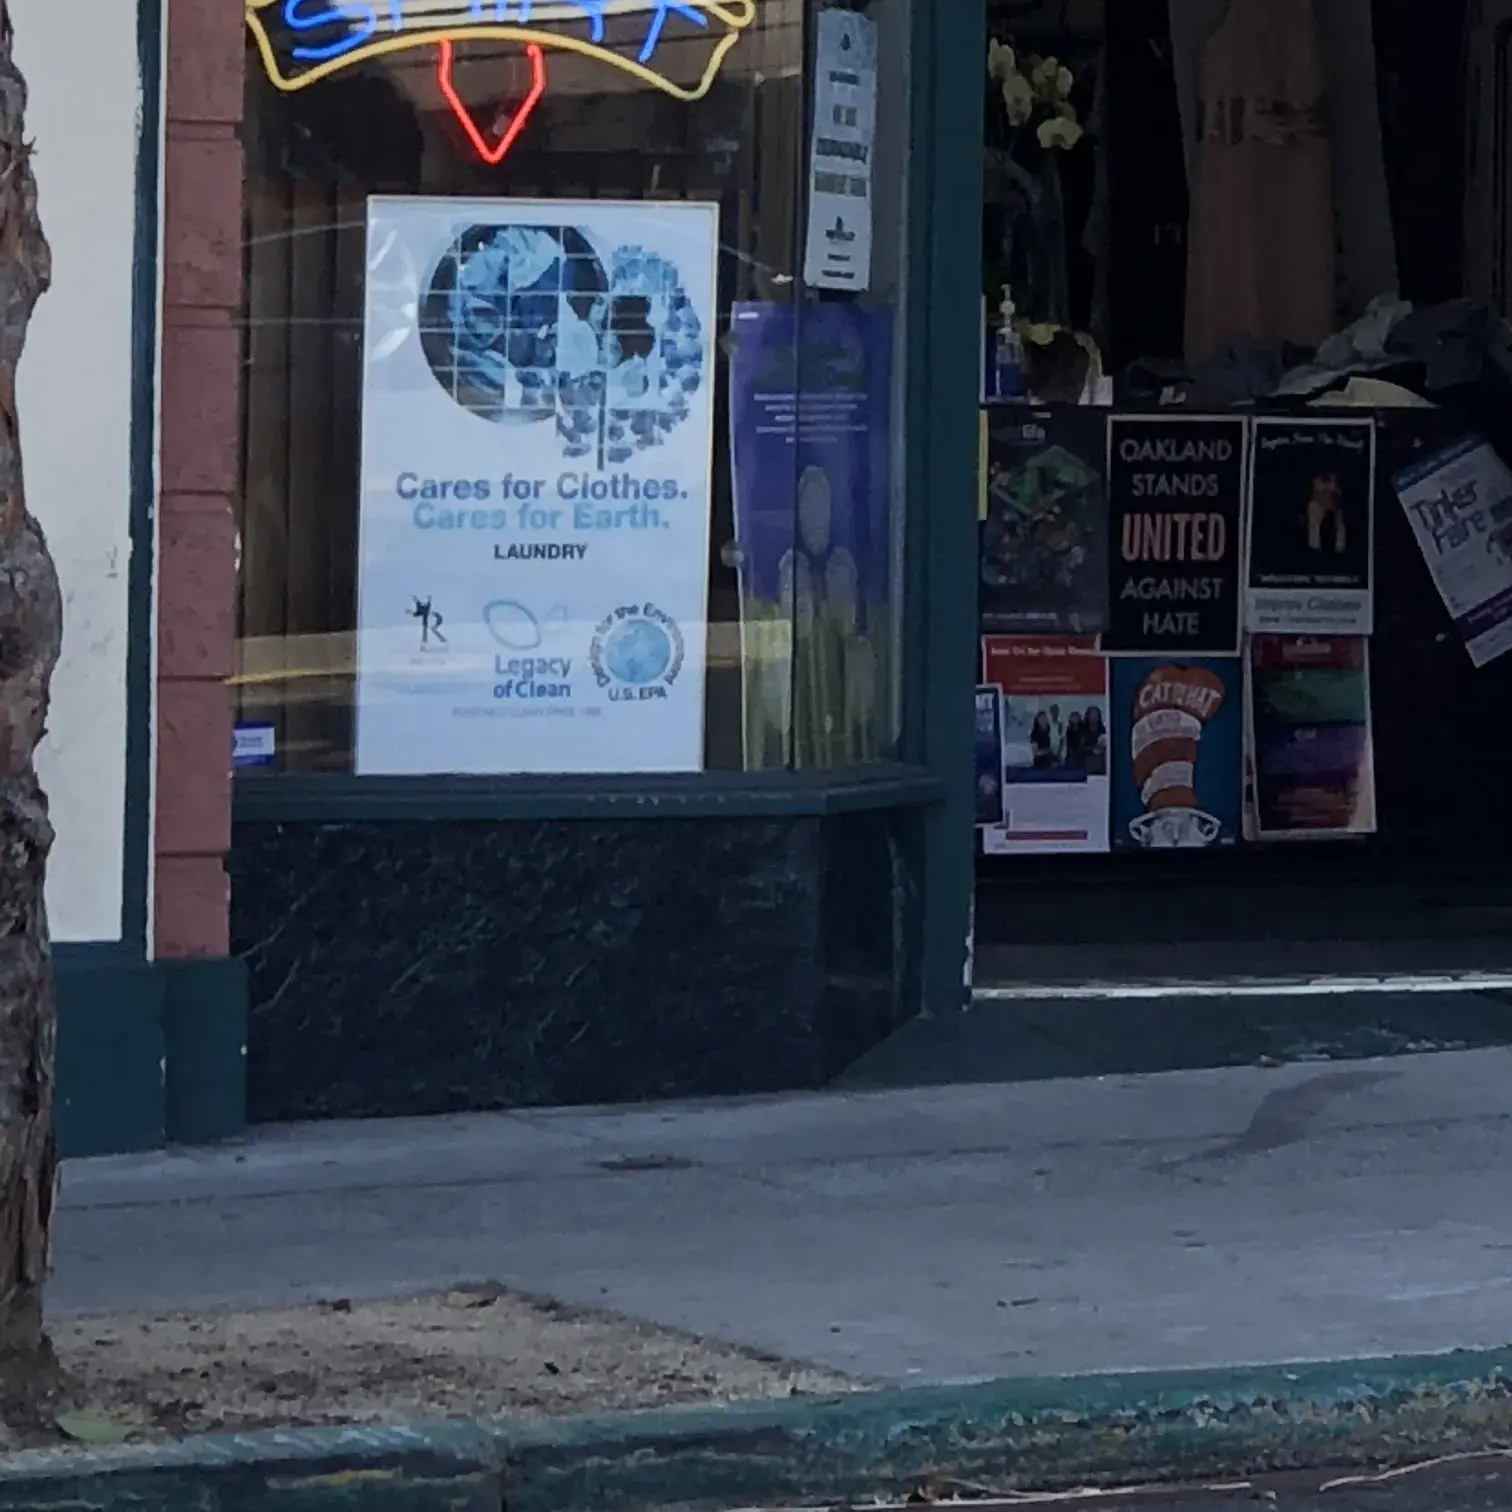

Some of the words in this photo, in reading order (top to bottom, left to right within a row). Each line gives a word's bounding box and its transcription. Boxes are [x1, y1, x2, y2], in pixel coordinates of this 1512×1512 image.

[1119, 439, 1233, 462] OAKLAND
[396, 472, 491, 500] Cares
[501, 472, 547, 500] for
[556, 472, 688, 500] Clothes.
[1132, 473, 1219, 496] STANDS
[413, 501, 506, 530] Cares
[517, 501, 562, 530] for
[573, 501, 670, 530] Earth.
[1121, 512, 1226, 561] UNITED
[494, 544, 588, 560] LAUNDRY
[1120, 577, 1224, 600] AGAINST
[1143, 612, 1200, 635] HATE
[494, 655, 571, 679] Legacy
